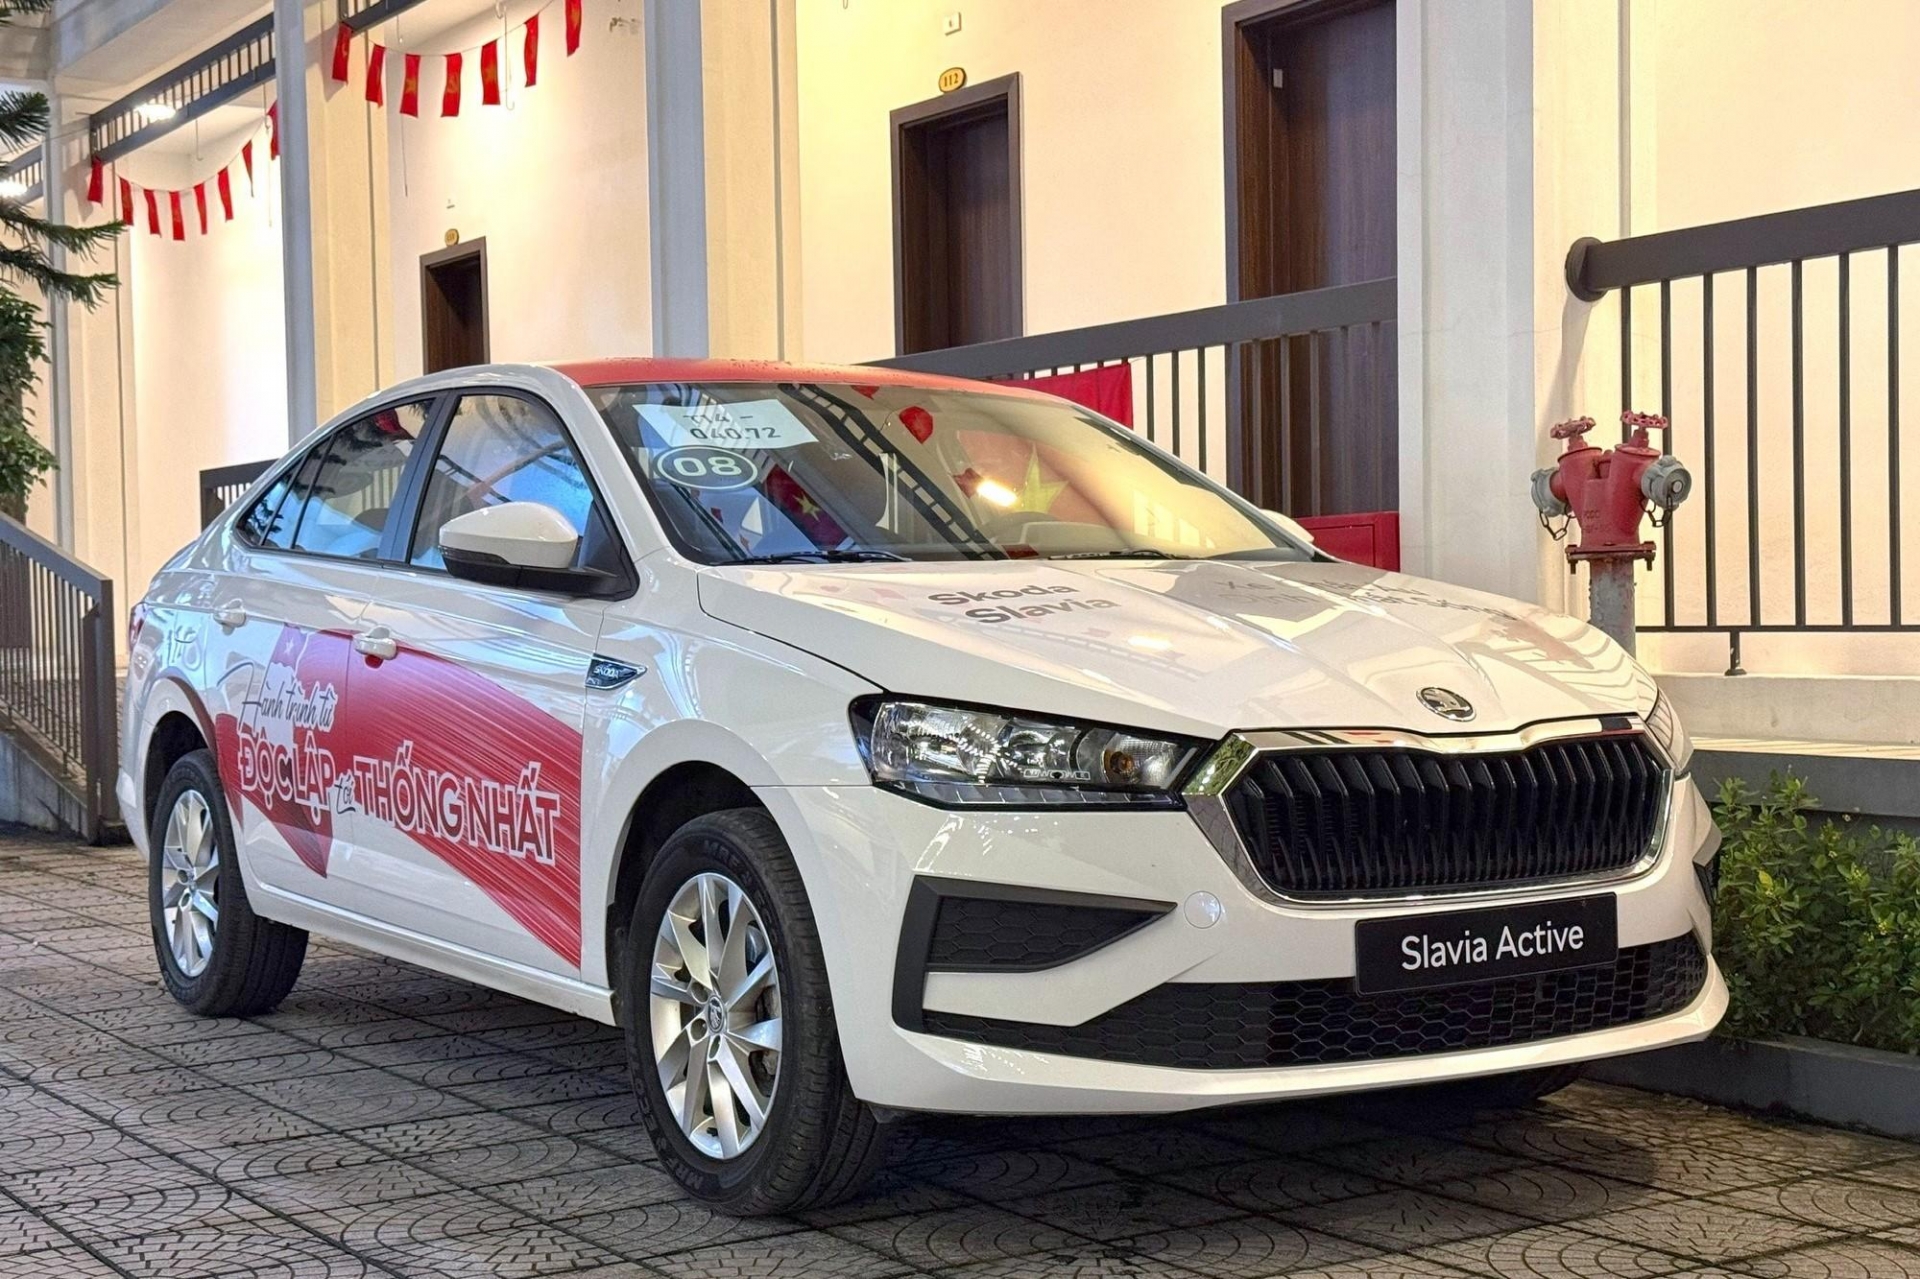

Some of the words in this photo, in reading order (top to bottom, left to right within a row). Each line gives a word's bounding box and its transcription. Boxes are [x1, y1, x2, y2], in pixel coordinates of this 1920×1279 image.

[944, 73, 959, 87] 112
[673, 456, 742, 477] 08
[927, 585, 1081, 606] Skoda
[965, 598, 1122, 624] Slavia
[238, 726, 294, 811] ĐỘC
[293, 730, 337, 826] LẬP
[353, 740, 468, 845] THỐNG
[465, 761, 561, 867] NHẤT
[1401, 930, 1488, 971] Slavia
[1495, 920, 1585, 961] Active
